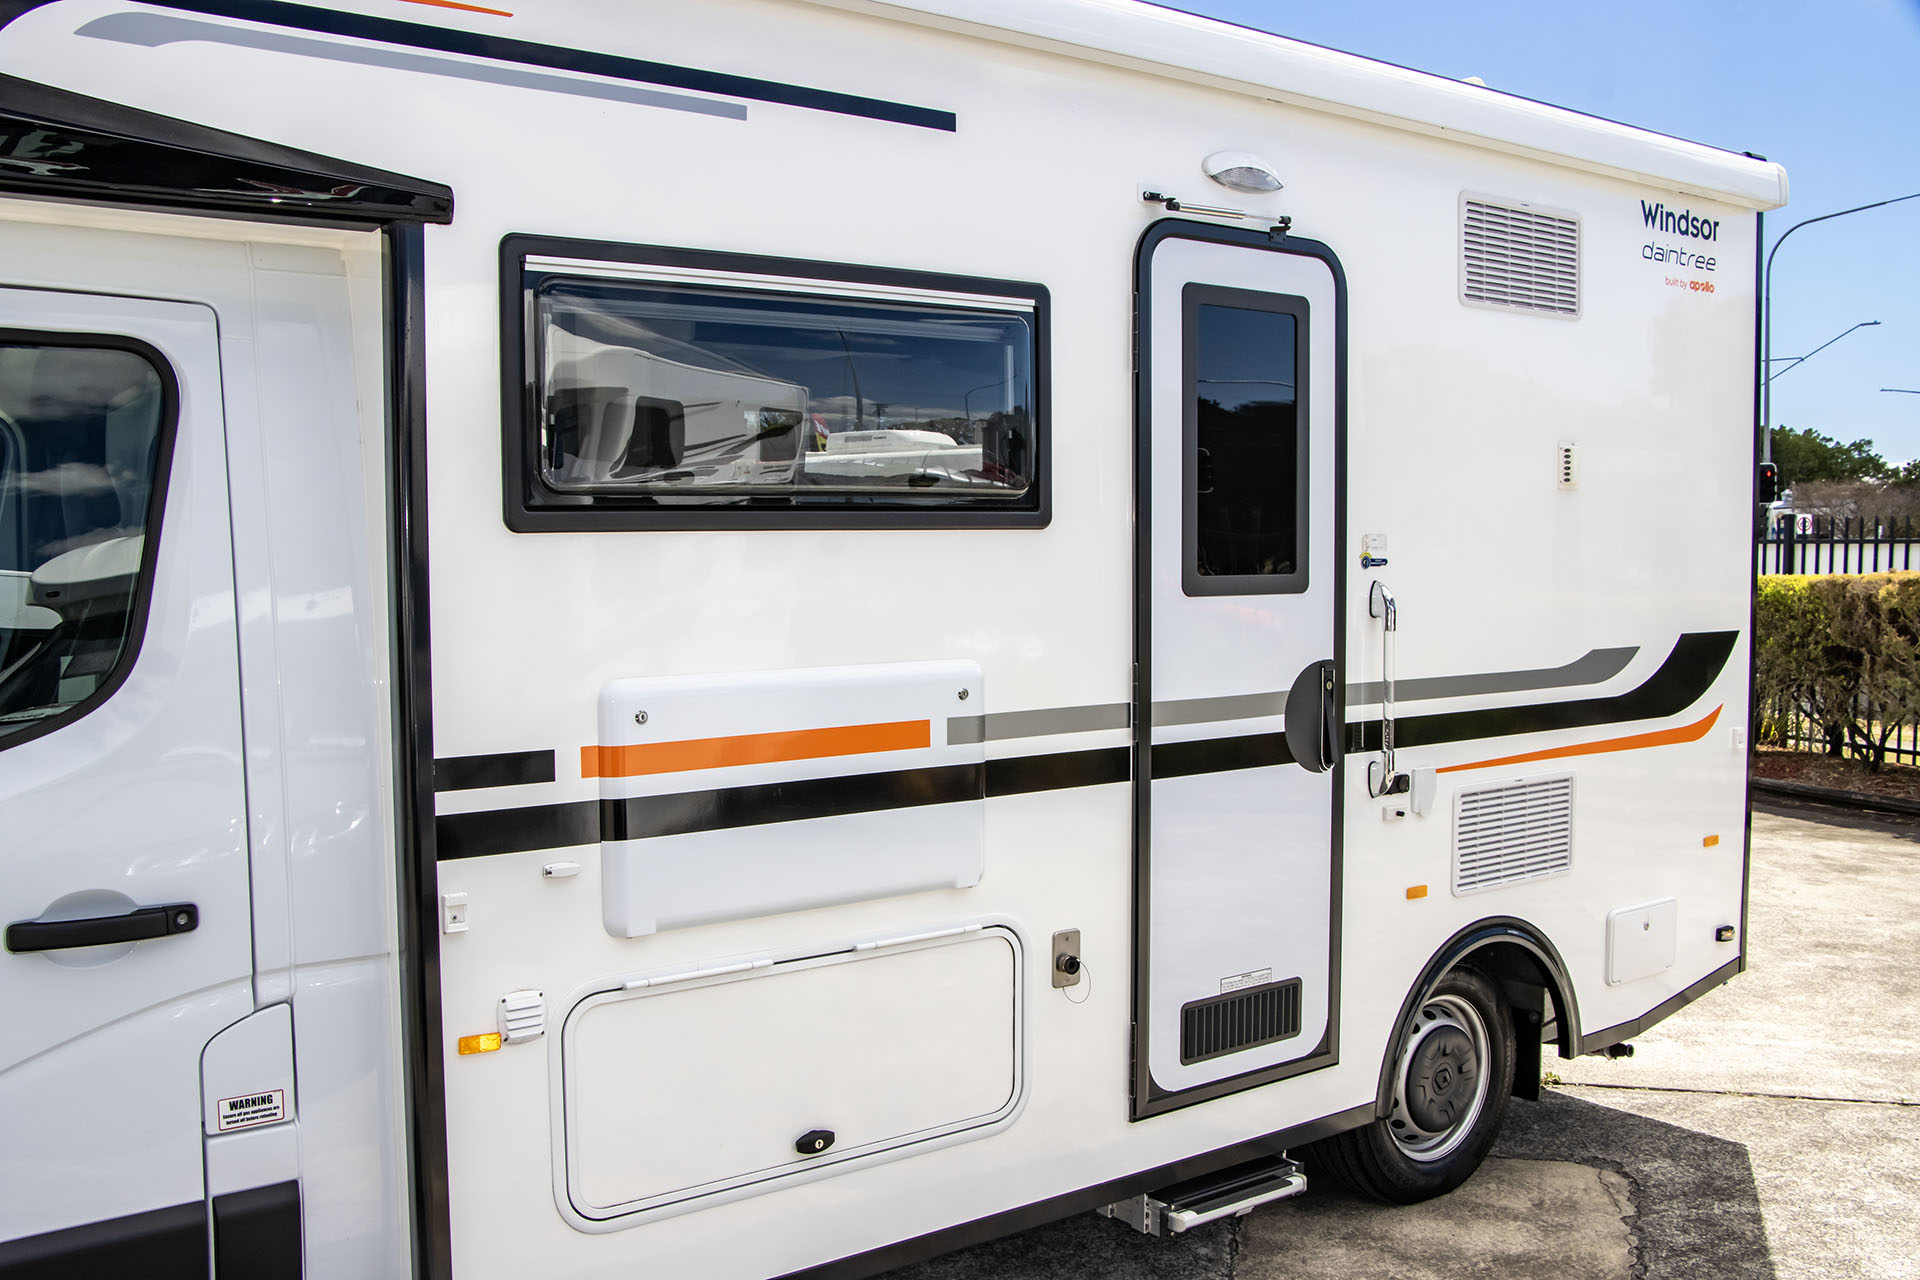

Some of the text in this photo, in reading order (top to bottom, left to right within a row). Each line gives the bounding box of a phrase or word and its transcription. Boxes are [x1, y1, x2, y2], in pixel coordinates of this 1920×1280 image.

[1641, 199, 1719, 241] Windsor
[1642, 241, 1716, 271] daintree
[1665, 276, 1715, 294] built by apollo
[229, 1094, 273, 1111] WARNING
